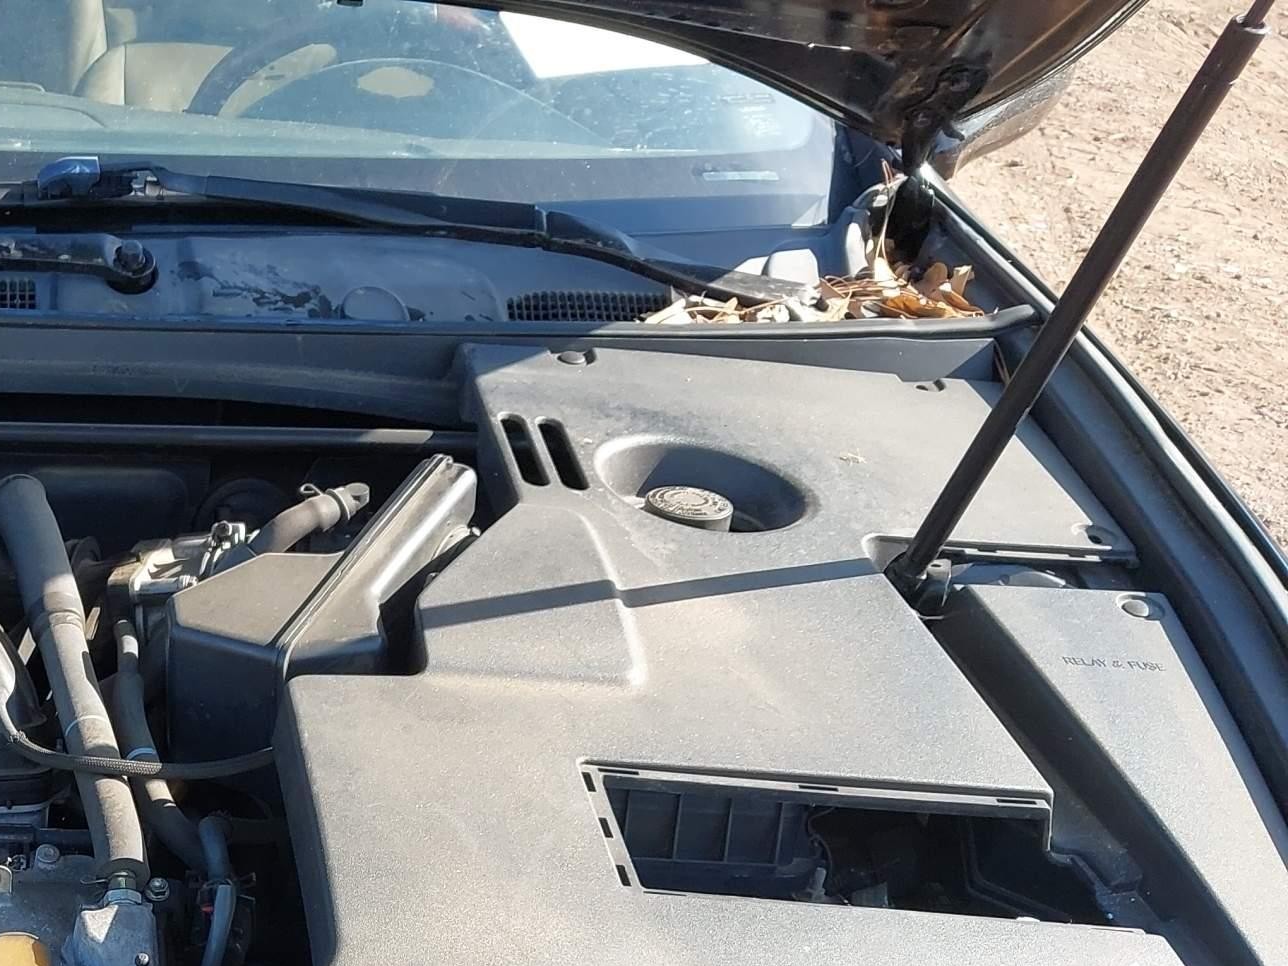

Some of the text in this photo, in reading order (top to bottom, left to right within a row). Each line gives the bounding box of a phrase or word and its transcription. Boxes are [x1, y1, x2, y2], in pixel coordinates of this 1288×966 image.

[1062, 656, 1166, 672] RELAY & FUSE
